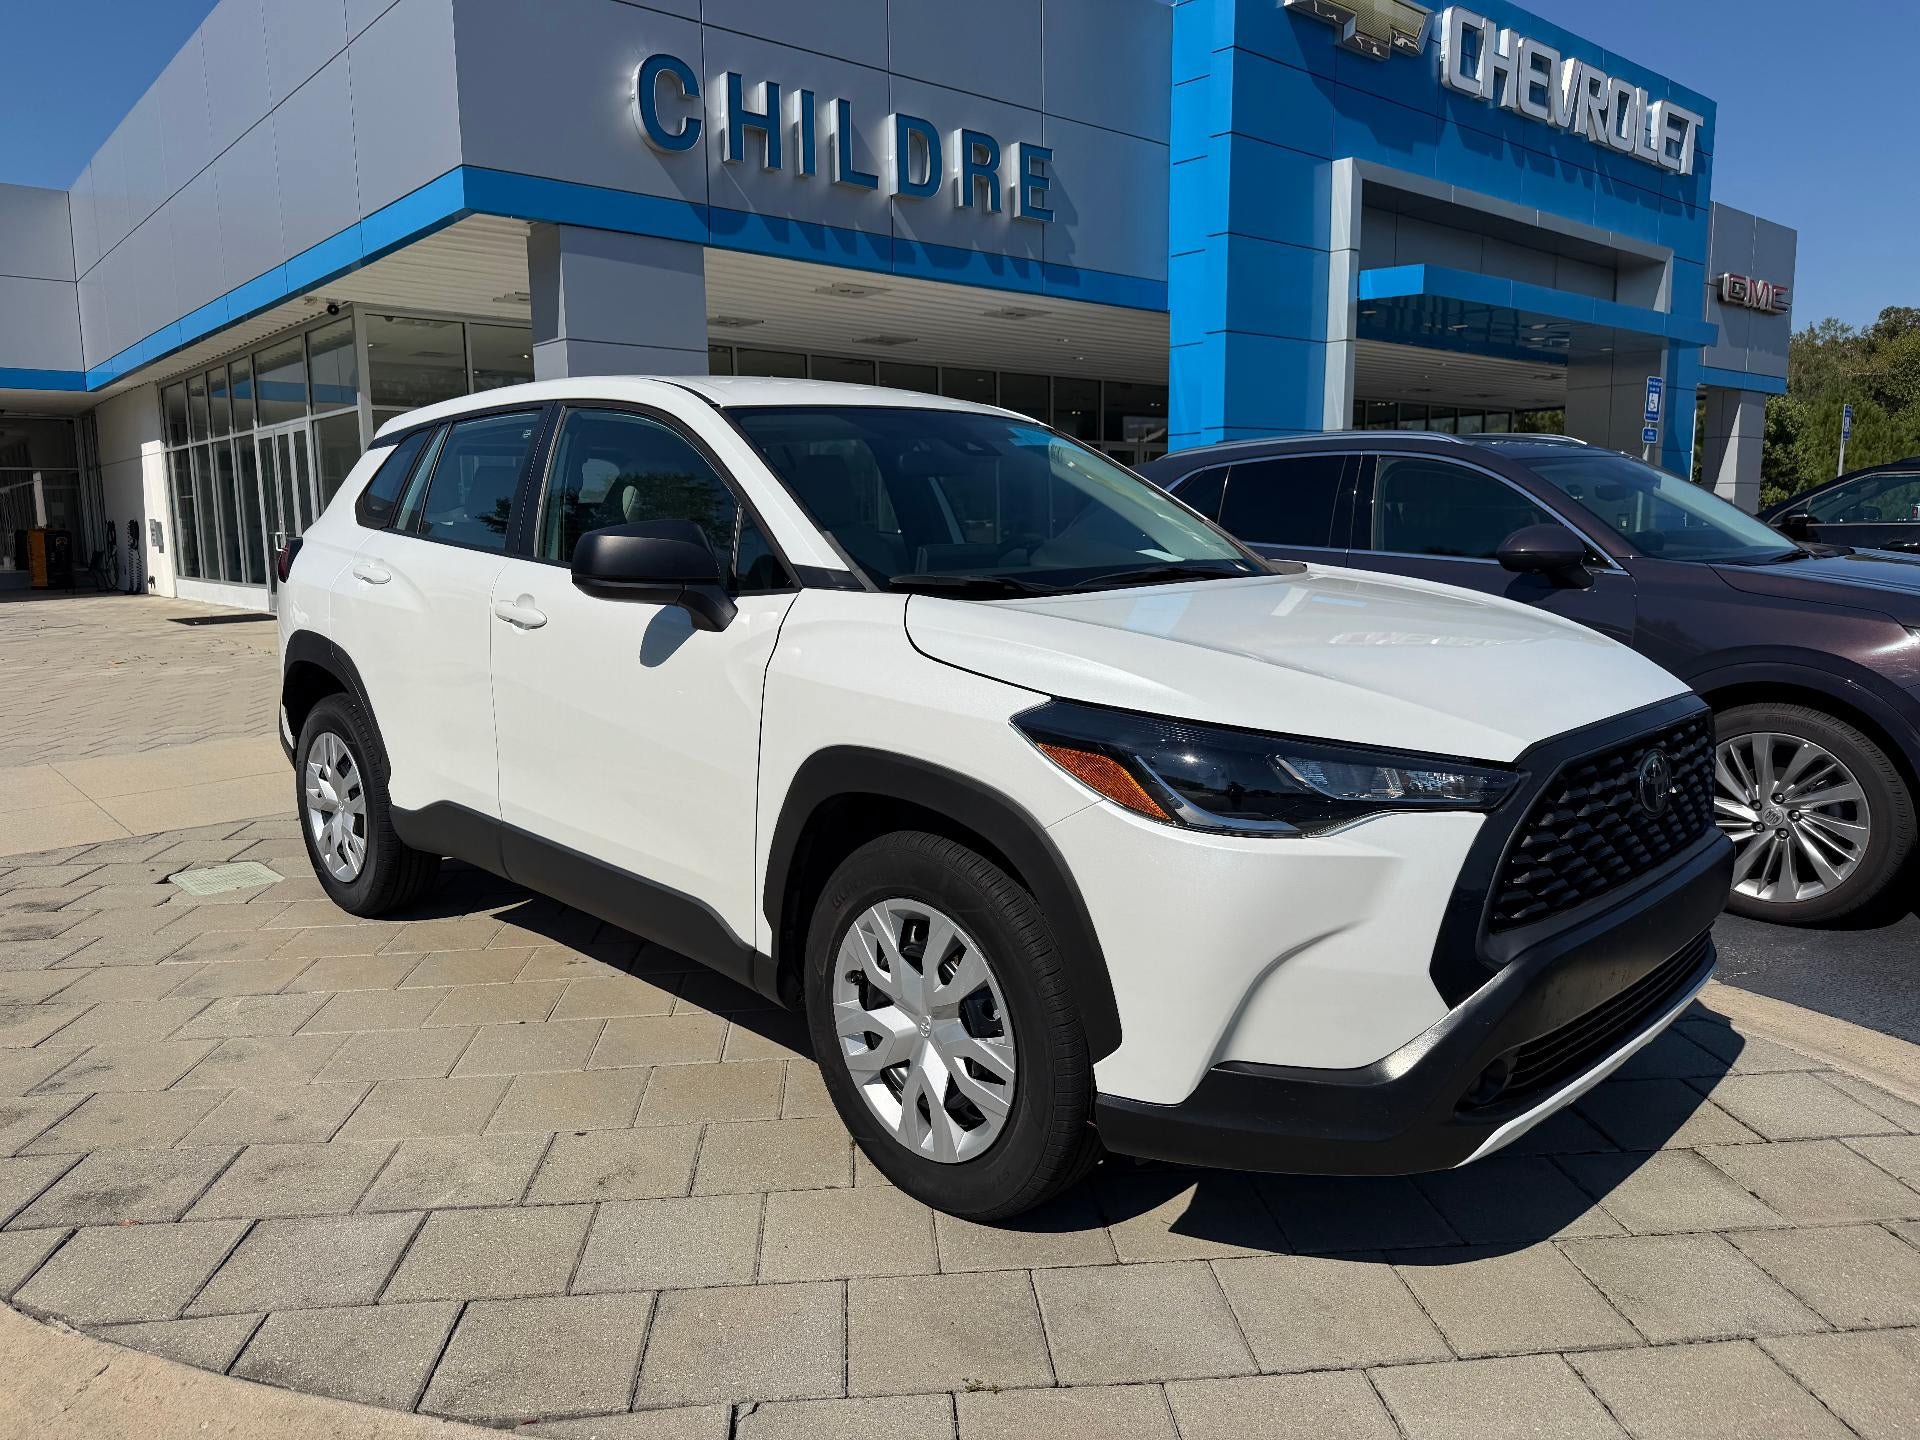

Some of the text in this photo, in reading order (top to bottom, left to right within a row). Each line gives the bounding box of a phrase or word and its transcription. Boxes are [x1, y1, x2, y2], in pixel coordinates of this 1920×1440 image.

[633, 53, 1055, 223] CHILDRE
[1441, 6, 1704, 176] CHEVROLET
[1721, 272, 1789, 314] GMC
